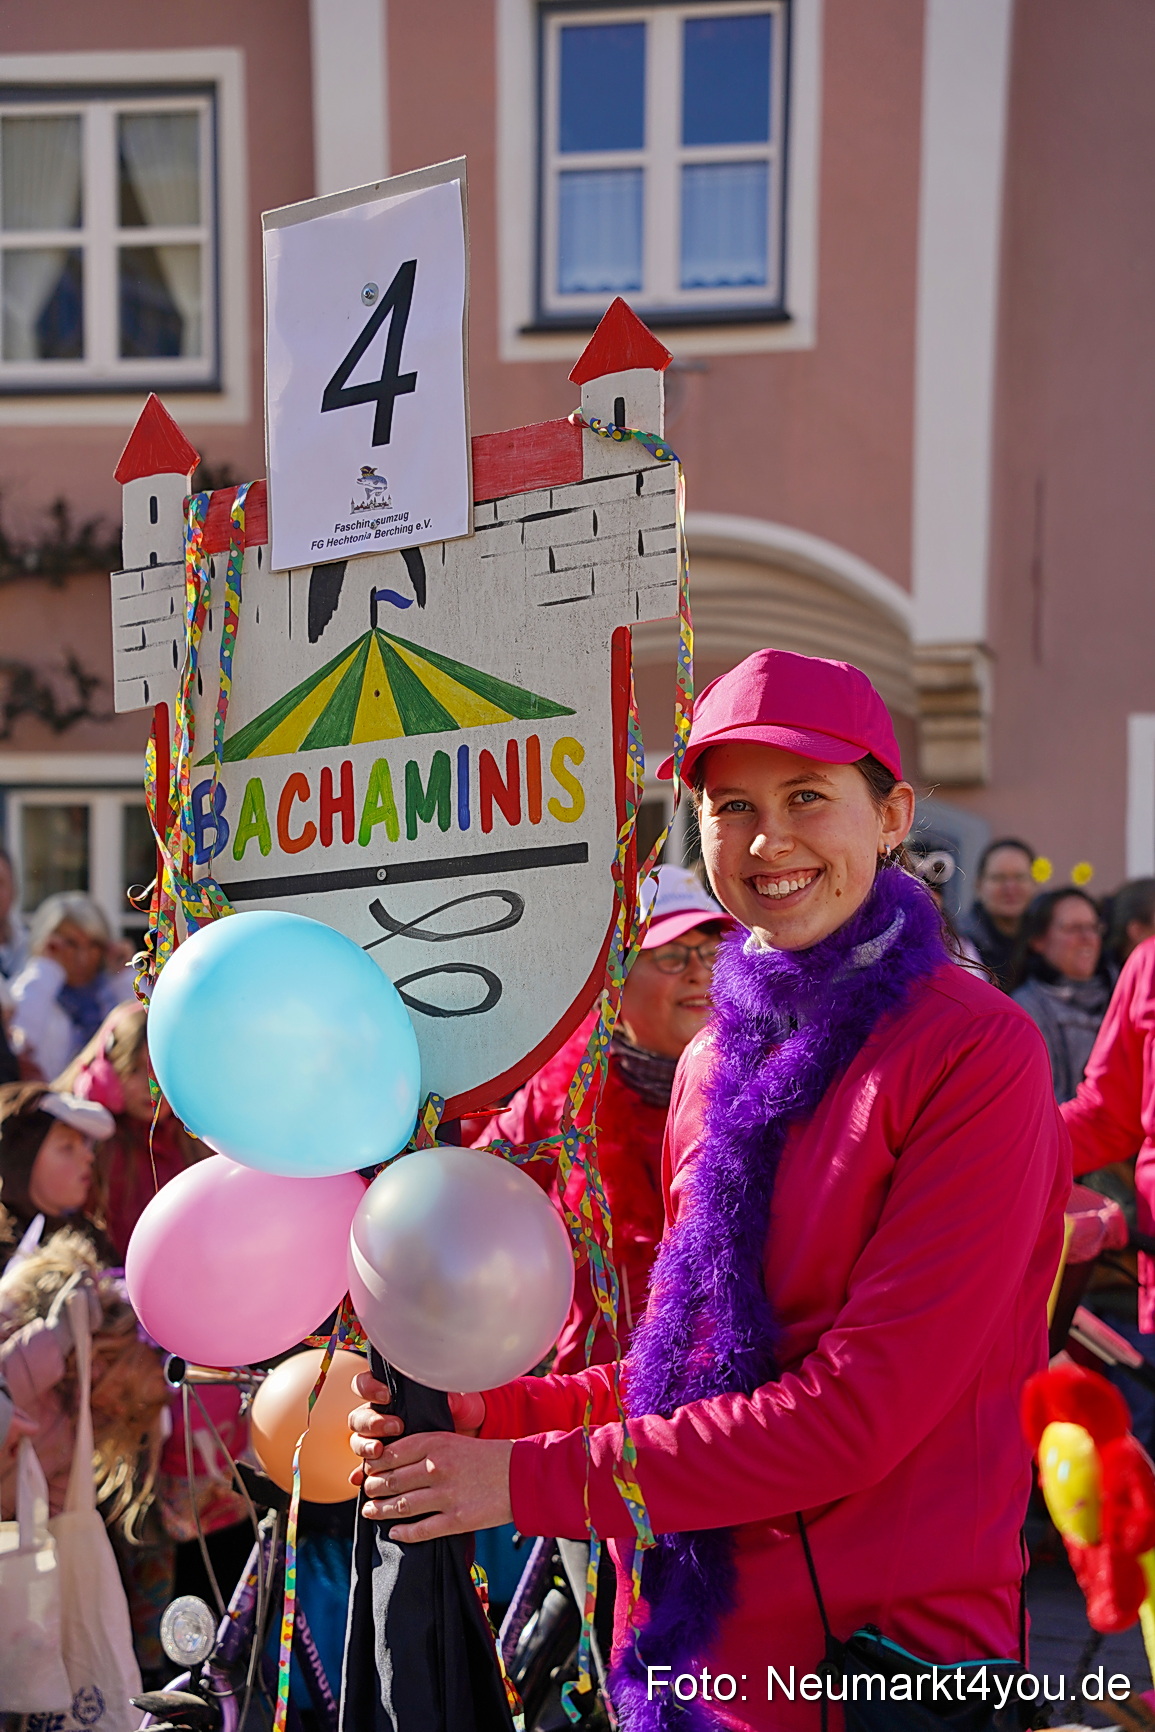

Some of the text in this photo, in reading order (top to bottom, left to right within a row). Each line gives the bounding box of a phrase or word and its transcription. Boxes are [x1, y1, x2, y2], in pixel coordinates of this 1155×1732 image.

[320, 259, 418, 447] 4
[310, 518, 433, 550] FG Hechtonia Berching e.V.
[334, 511, 410, 533] Faschinsumzug
[191, 733, 586, 866] BACHAMINIS
